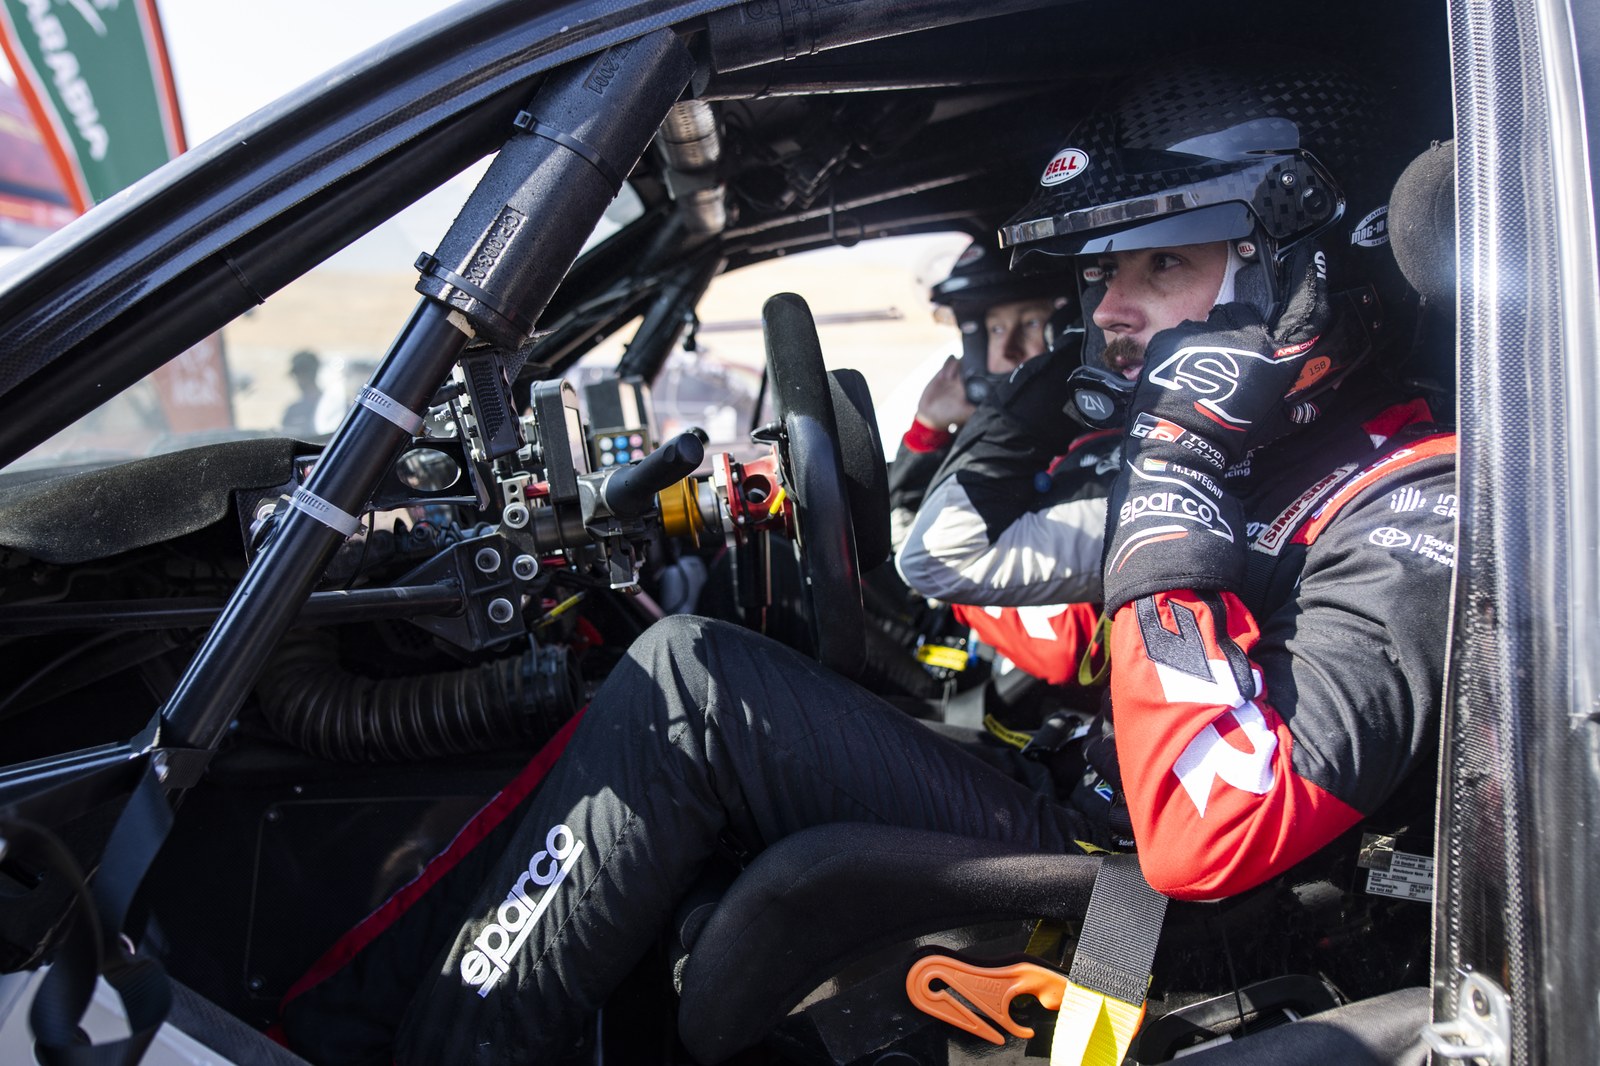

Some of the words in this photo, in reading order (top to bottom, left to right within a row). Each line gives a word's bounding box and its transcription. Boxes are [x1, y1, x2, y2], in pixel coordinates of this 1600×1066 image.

[1045, 155, 1078, 177] BELL
[1309, 360, 1327, 377] 158
[1188, 433, 1226, 469] TOYOT
[1119, 492, 1213, 522] sparco
[1263, 474, 1338, 544] SIMPSON
[1424, 534, 1456, 553] Toyo
[1418, 546, 1456, 568] Finan
[460, 824, 575, 985] sparco
